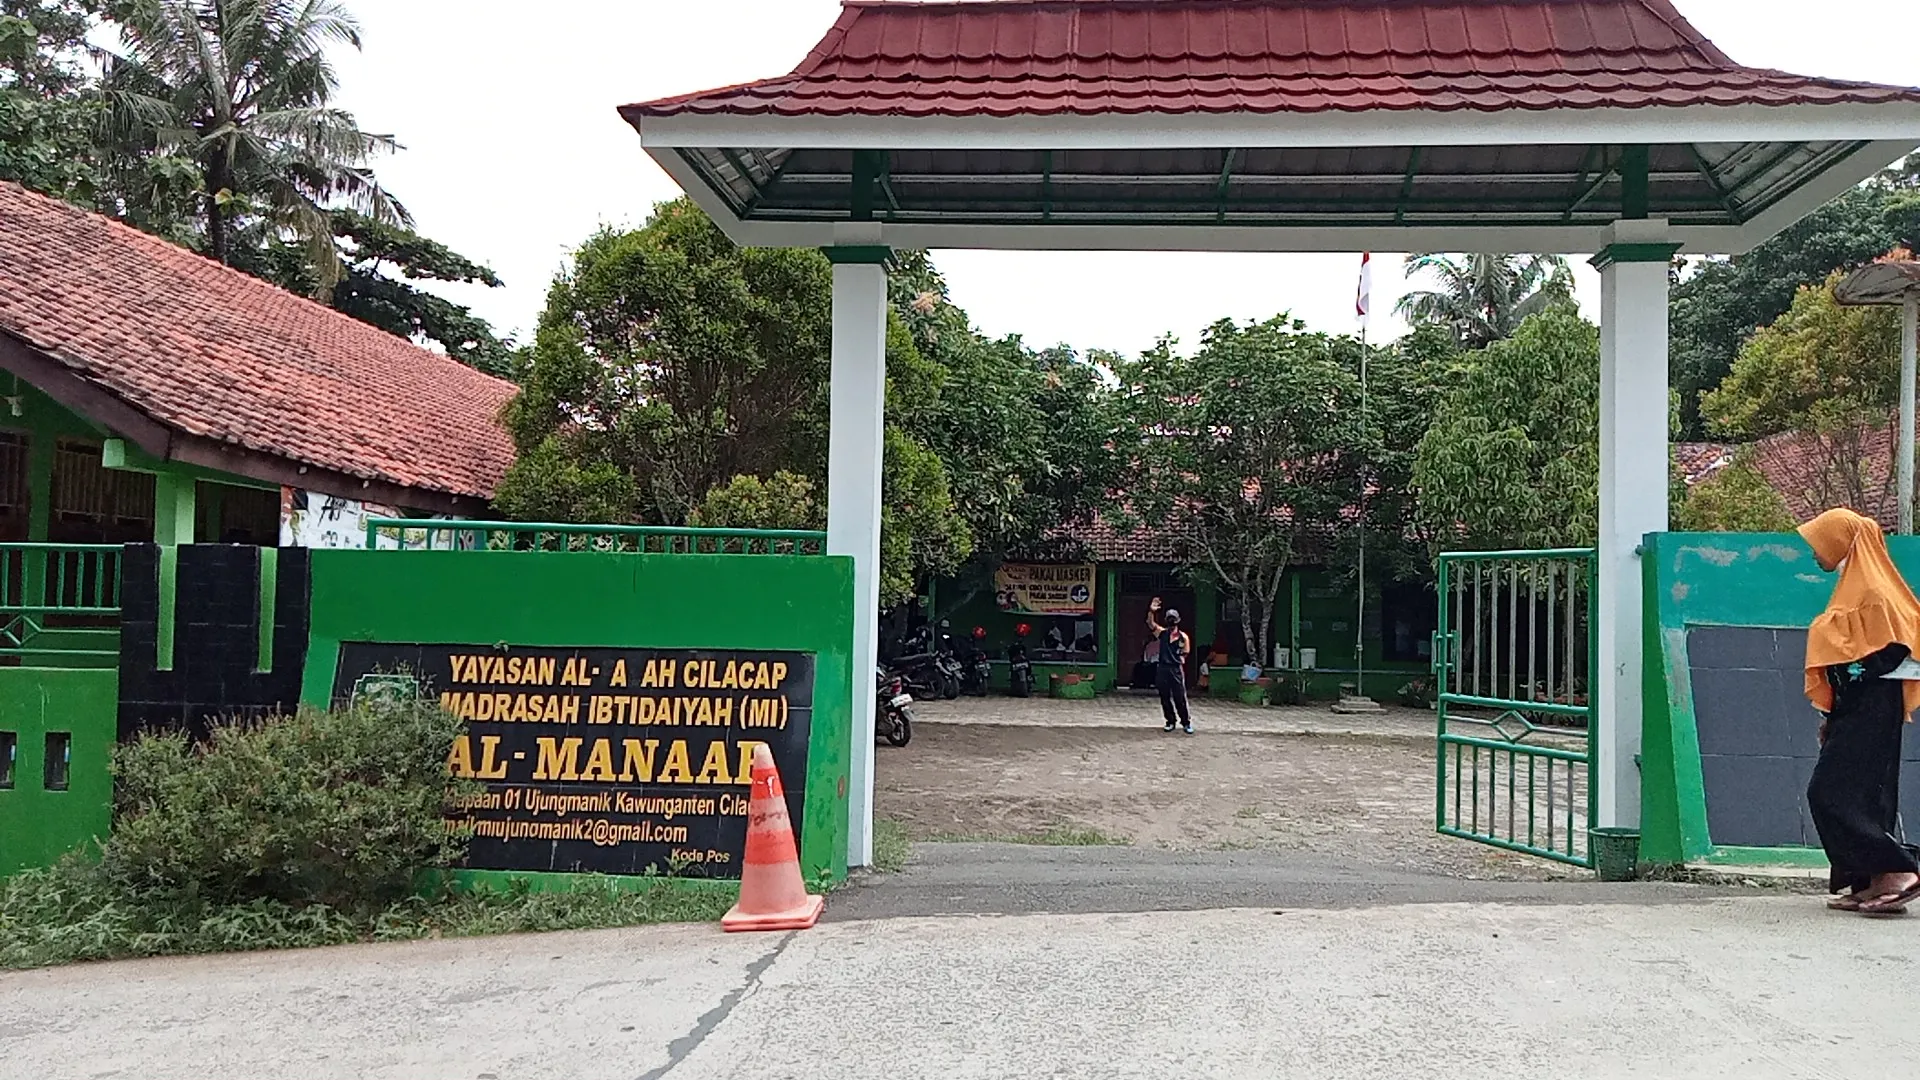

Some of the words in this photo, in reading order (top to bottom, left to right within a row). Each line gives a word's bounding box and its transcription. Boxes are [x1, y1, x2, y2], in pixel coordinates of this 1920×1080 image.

[449, 655, 556, 686] YAYASAN
[683, 659, 788, 690] CILACAP
[440, 691, 580, 724] MADRASAH
[587, 694, 734, 727] IBTIDAIYAH
[739, 694, 788, 731] (MI)
[504, 787, 521, 811] 01
[525, 788, 613, 817] Ujungmanik
[614, 790, 715, 821] Kawunganten
[670, 848, 704, 864] Kode
[706, 849, 731, 864] Pos
